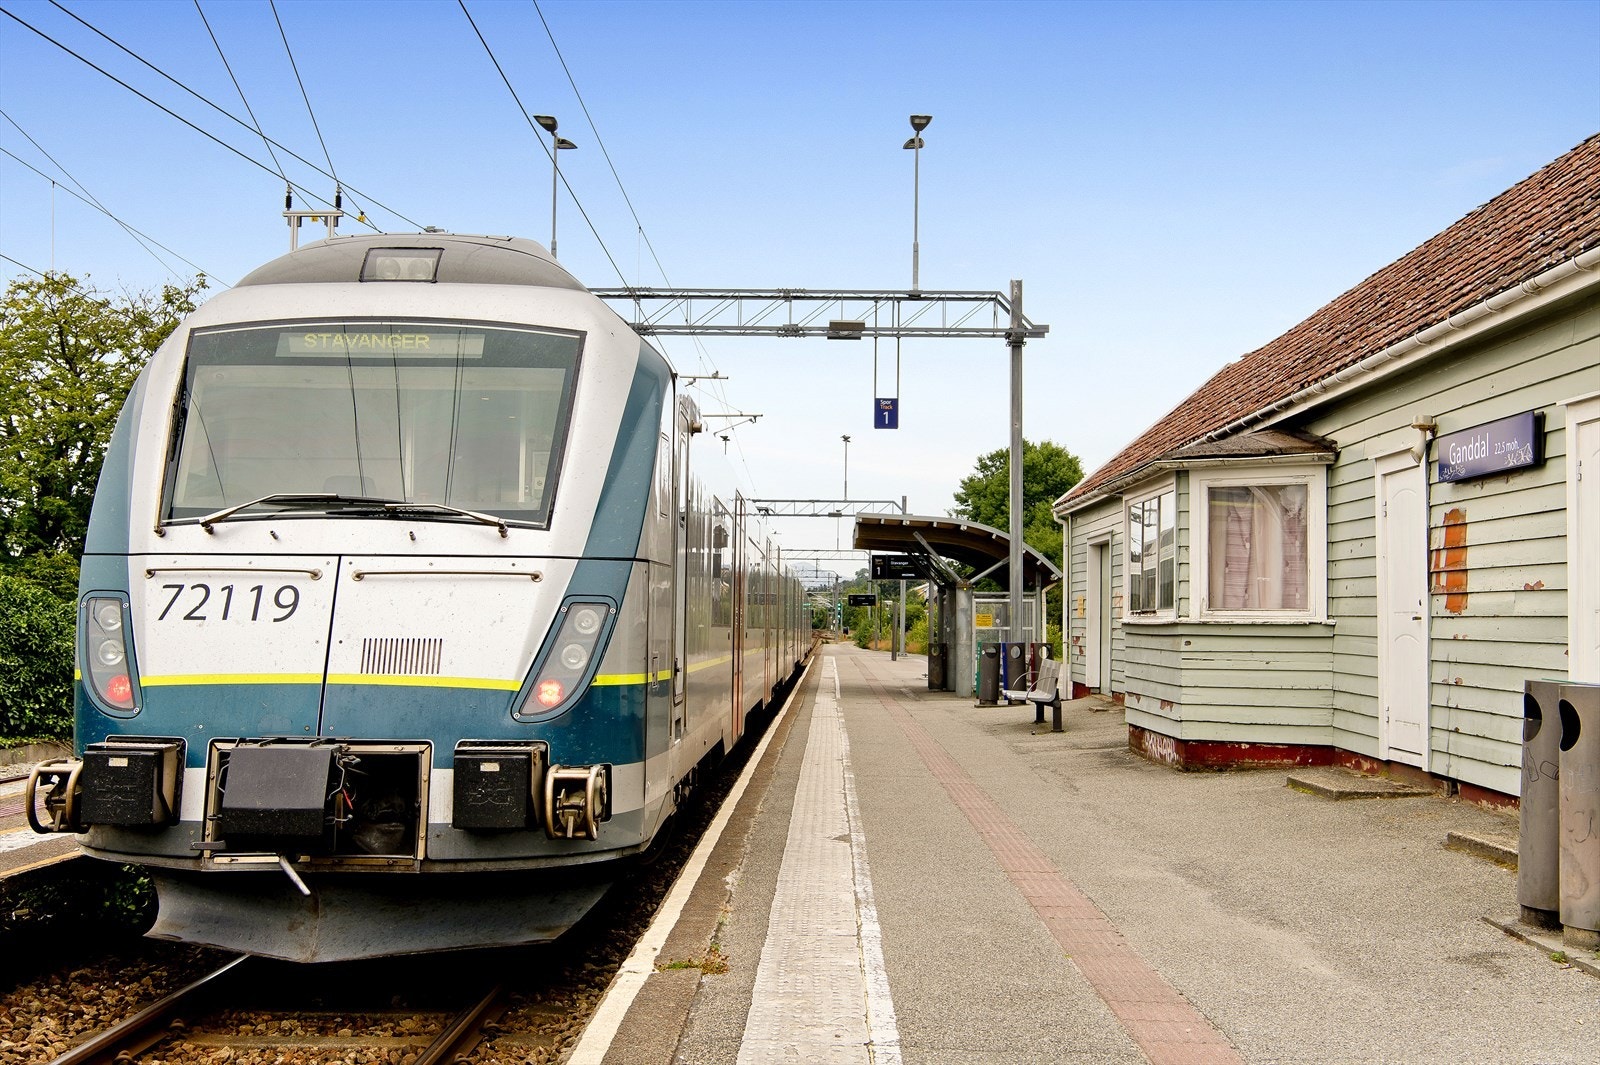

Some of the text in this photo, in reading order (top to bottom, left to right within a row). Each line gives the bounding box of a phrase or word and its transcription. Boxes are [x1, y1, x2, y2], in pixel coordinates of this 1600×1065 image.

[303, 333, 431, 350] STAVANGER
[883, 411, 889, 425] 1
[1449, 432, 1489, 465] Ganddal
[876, 566, 881, 576] 1
[158, 583, 300, 622] 72119
